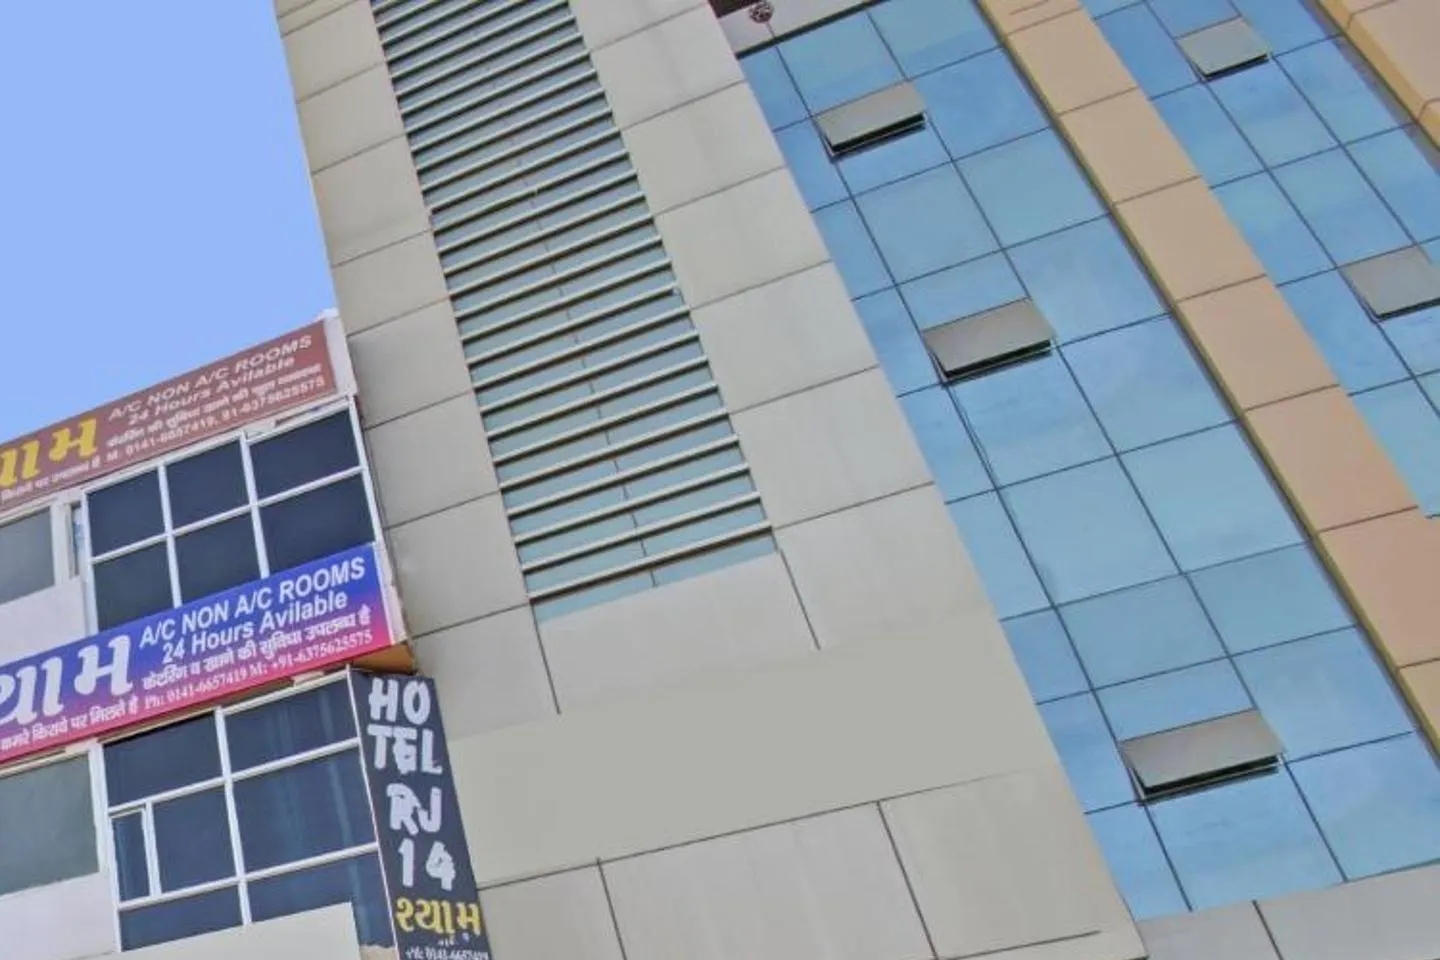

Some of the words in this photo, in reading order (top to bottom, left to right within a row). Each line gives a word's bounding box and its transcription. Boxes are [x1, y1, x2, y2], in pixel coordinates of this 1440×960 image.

[109, 399, 143, 420] A/C
[147, 381, 190, 406] NON
[194, 366, 230, 385] A/C
[235, 335, 312, 373] ROOMS
[128, 412, 149, 425] 24
[155, 389, 211, 415] Hours
[217, 357, 295, 396] Avilable
[139, 619, 175, 648] A/C
[182, 599, 229, 634] NON
[235, 587, 272, 616] A/C
[279, 557, 366, 603] ROOMS
[163, 639, 185, 664] 24
[191, 620, 254, 654] Hours
[260, 591, 348, 632] Avilable
[369, 678, 430, 723] HO
[367, 725, 443, 775] TEL
[386, 783, 442, 836] RJ
[397, 839, 456, 891] 14
